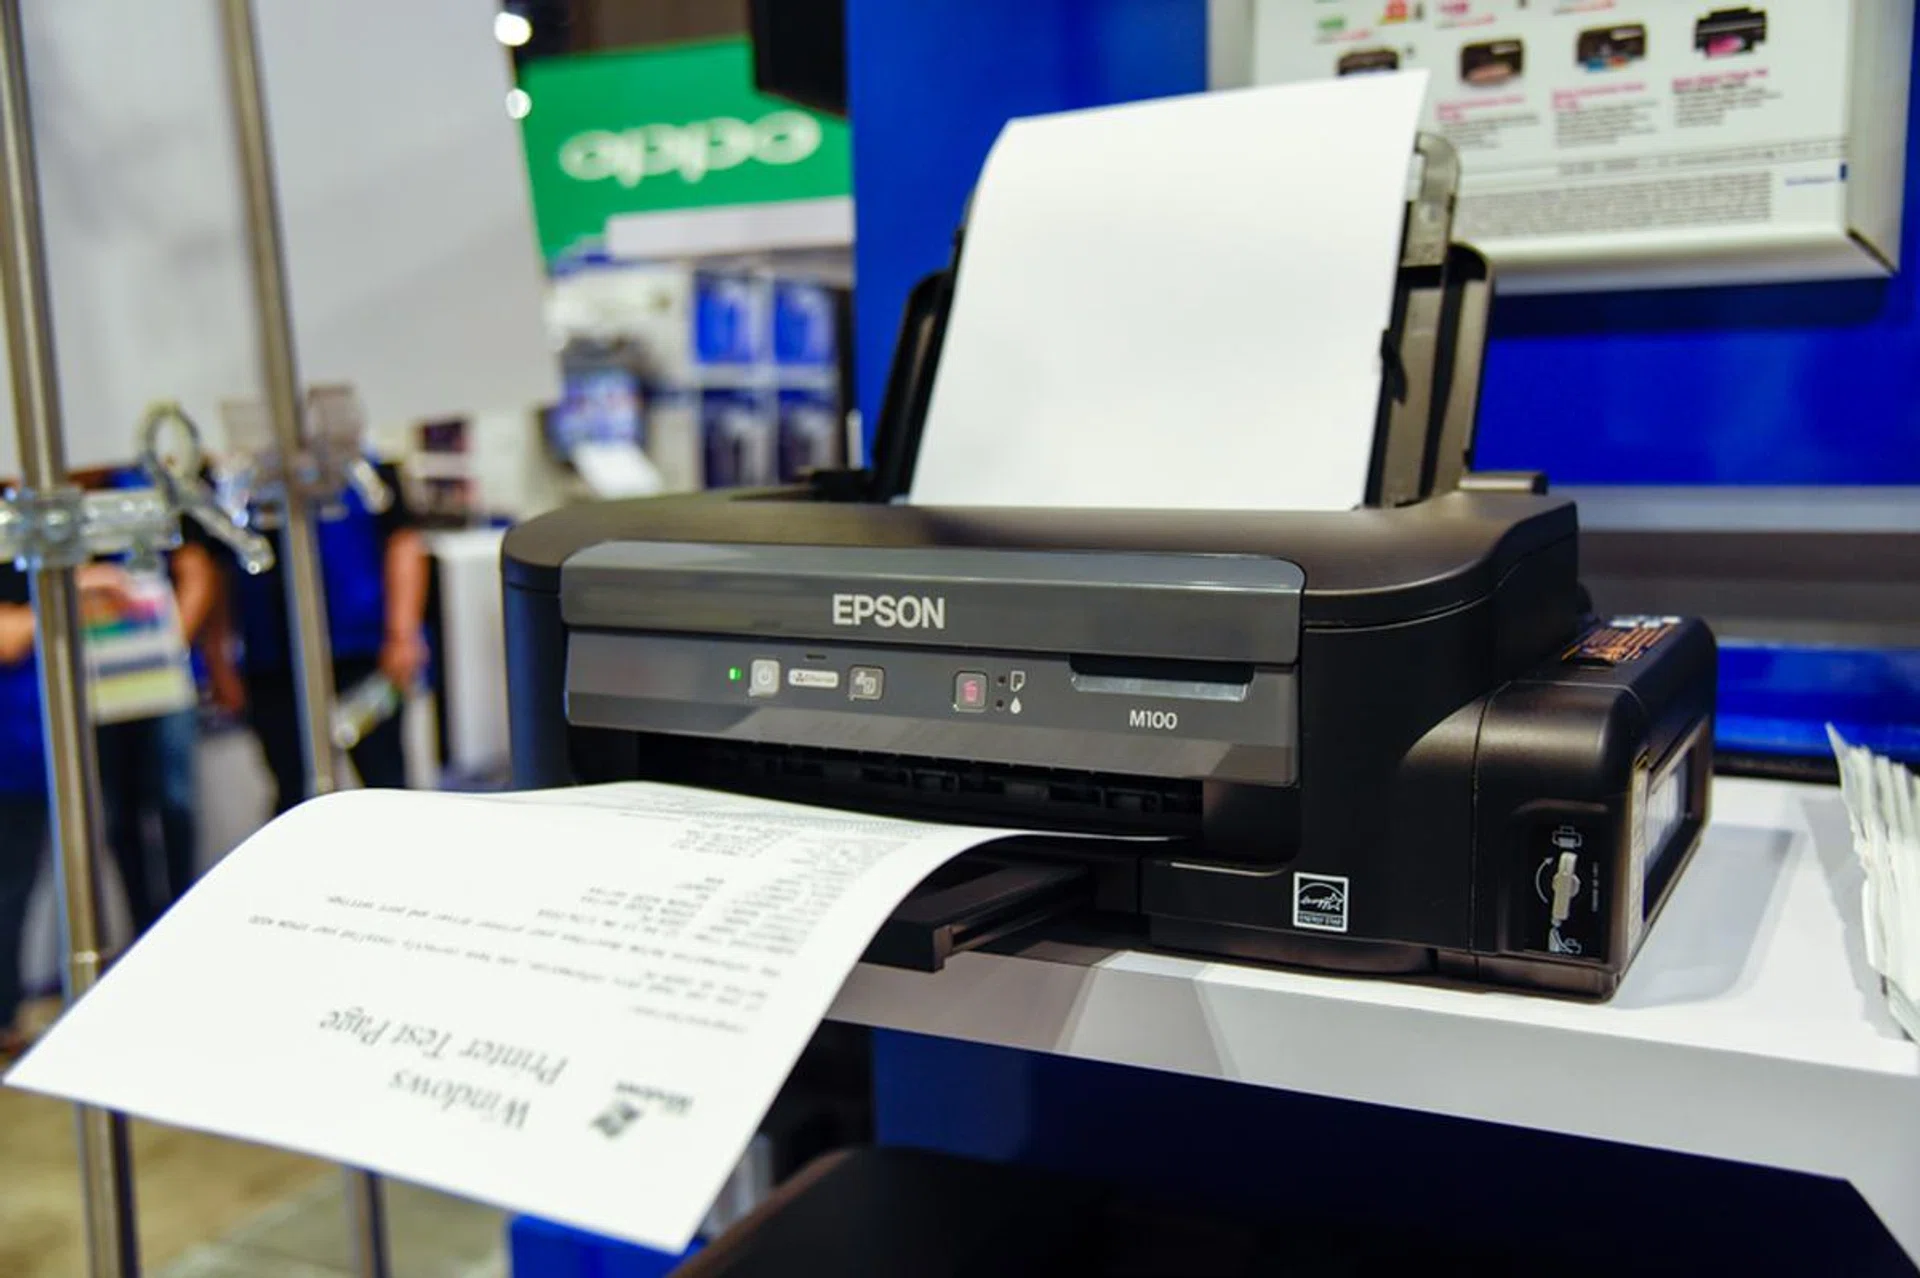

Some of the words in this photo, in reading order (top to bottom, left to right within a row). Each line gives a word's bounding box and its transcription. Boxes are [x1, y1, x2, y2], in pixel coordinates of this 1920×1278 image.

[558, 108, 822, 189] oppo
[832, 593, 946, 629] EPSON
[1129, 709, 1178, 730] M100
[318, 1006, 388, 1047] Page
[383, 1021, 450, 1060] Test
[457, 1036, 568, 1087] Printer
[389, 1071, 531, 1131] Windows
